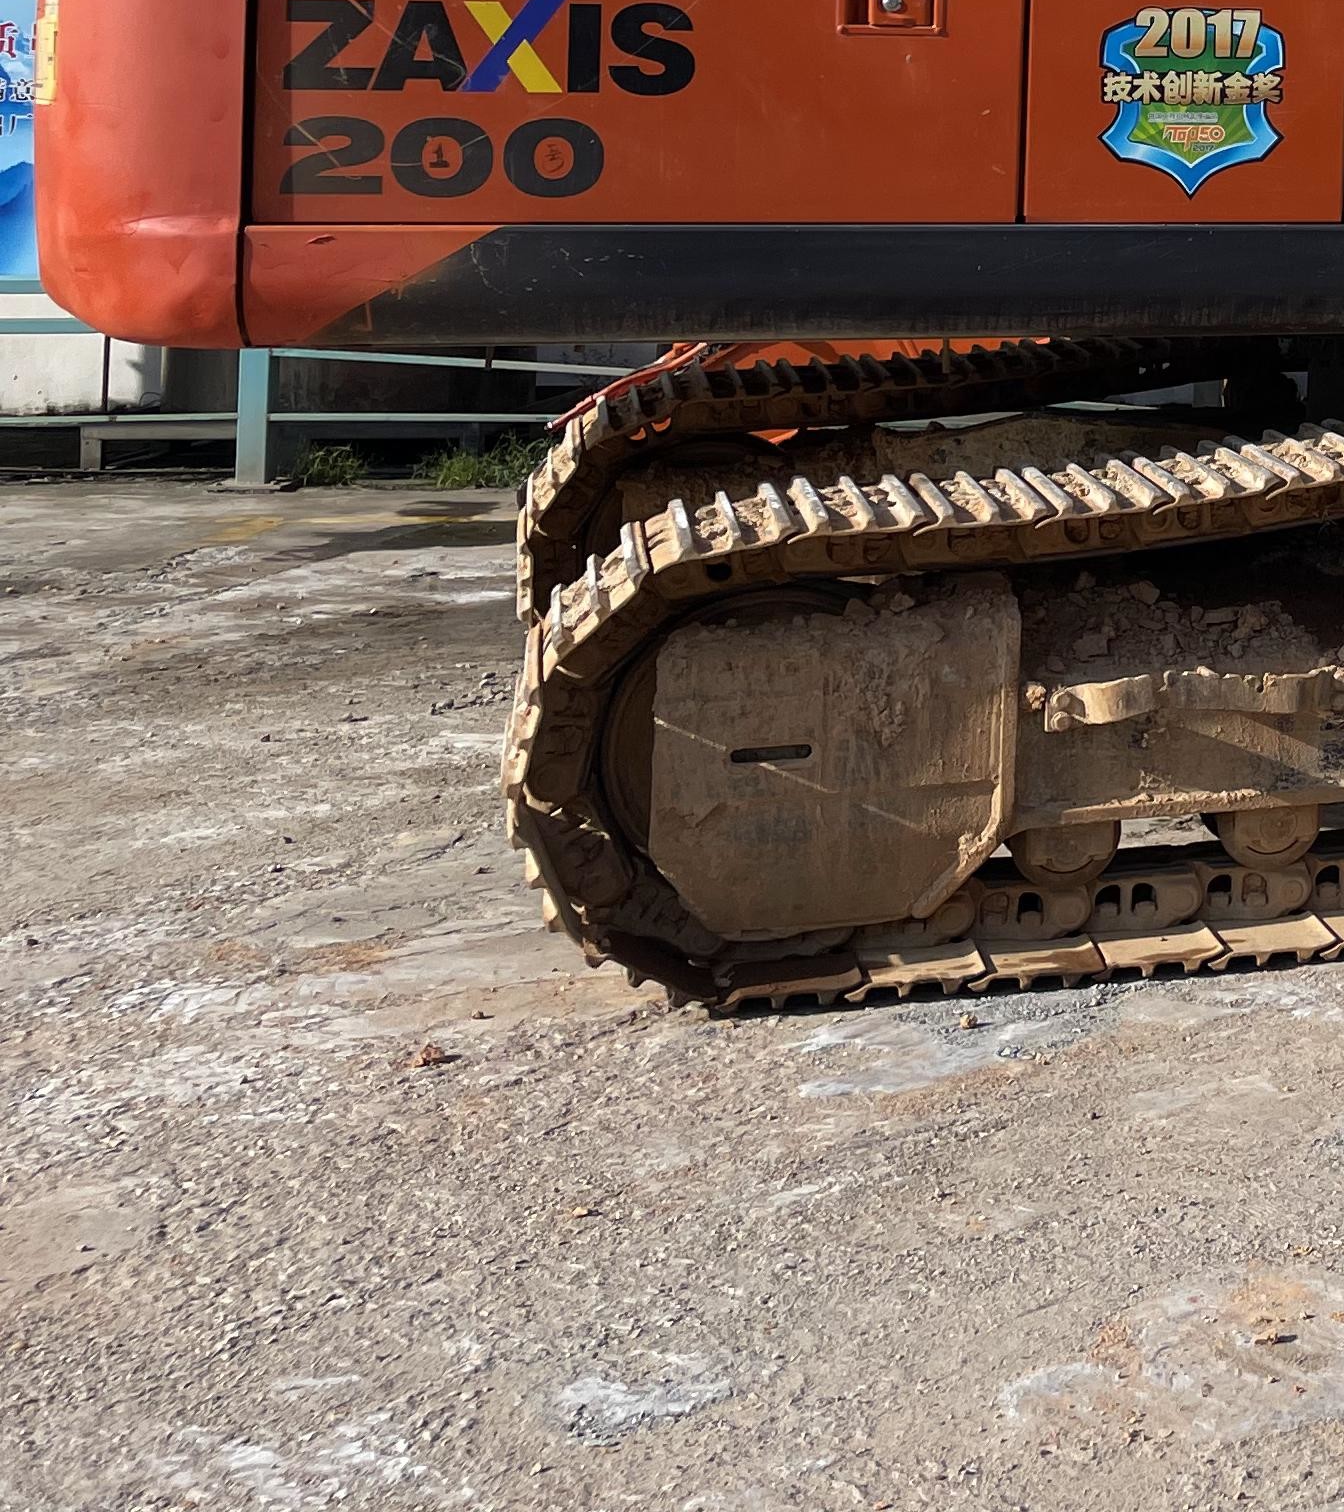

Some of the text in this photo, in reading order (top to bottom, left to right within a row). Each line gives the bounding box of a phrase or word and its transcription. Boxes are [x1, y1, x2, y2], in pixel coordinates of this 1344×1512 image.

[1134, 7, 1261, 58] 2017
[1103, 71, 1282, 105] 技术创新金奖
[280, 116, 604, 198] 200
